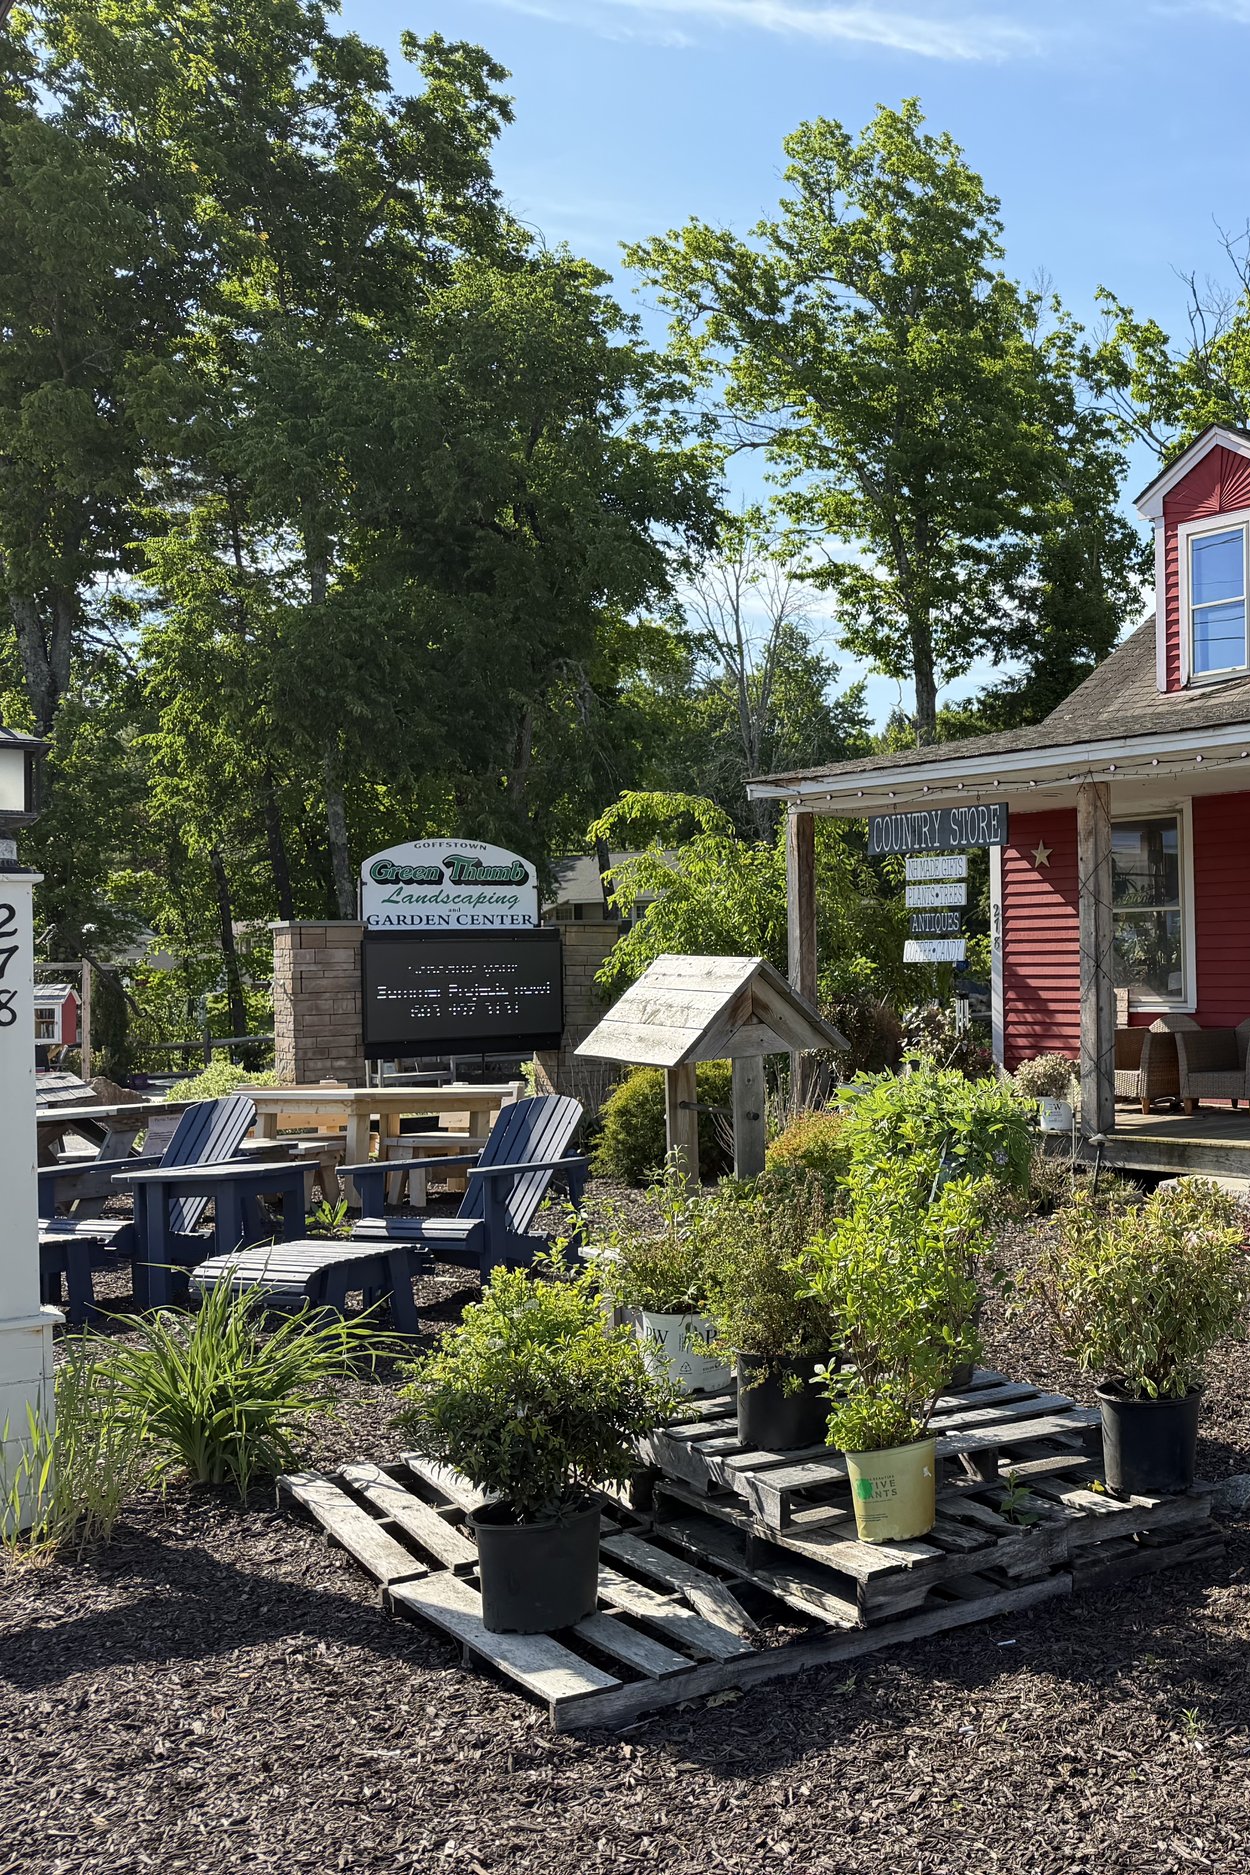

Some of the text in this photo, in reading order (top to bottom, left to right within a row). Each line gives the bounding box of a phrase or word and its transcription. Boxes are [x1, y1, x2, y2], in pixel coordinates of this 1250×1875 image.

[873, 805, 1001, 852] COUNTRY STORE
[414, 841, 487, 851] GOFFSTOWN
[370, 854, 529, 886] Green Thumb
[908, 857, 963, 879] NH MADE GIFTS
[381, 886, 520, 910] Landscaping
[908, 886, 963, 906] PLANTS TREES
[367, 914, 534, 926] GARDEN CENTER
[911, 912, 960, 933] ANTIQUES
[905, 940, 962, 961] COFFEE CANDY
